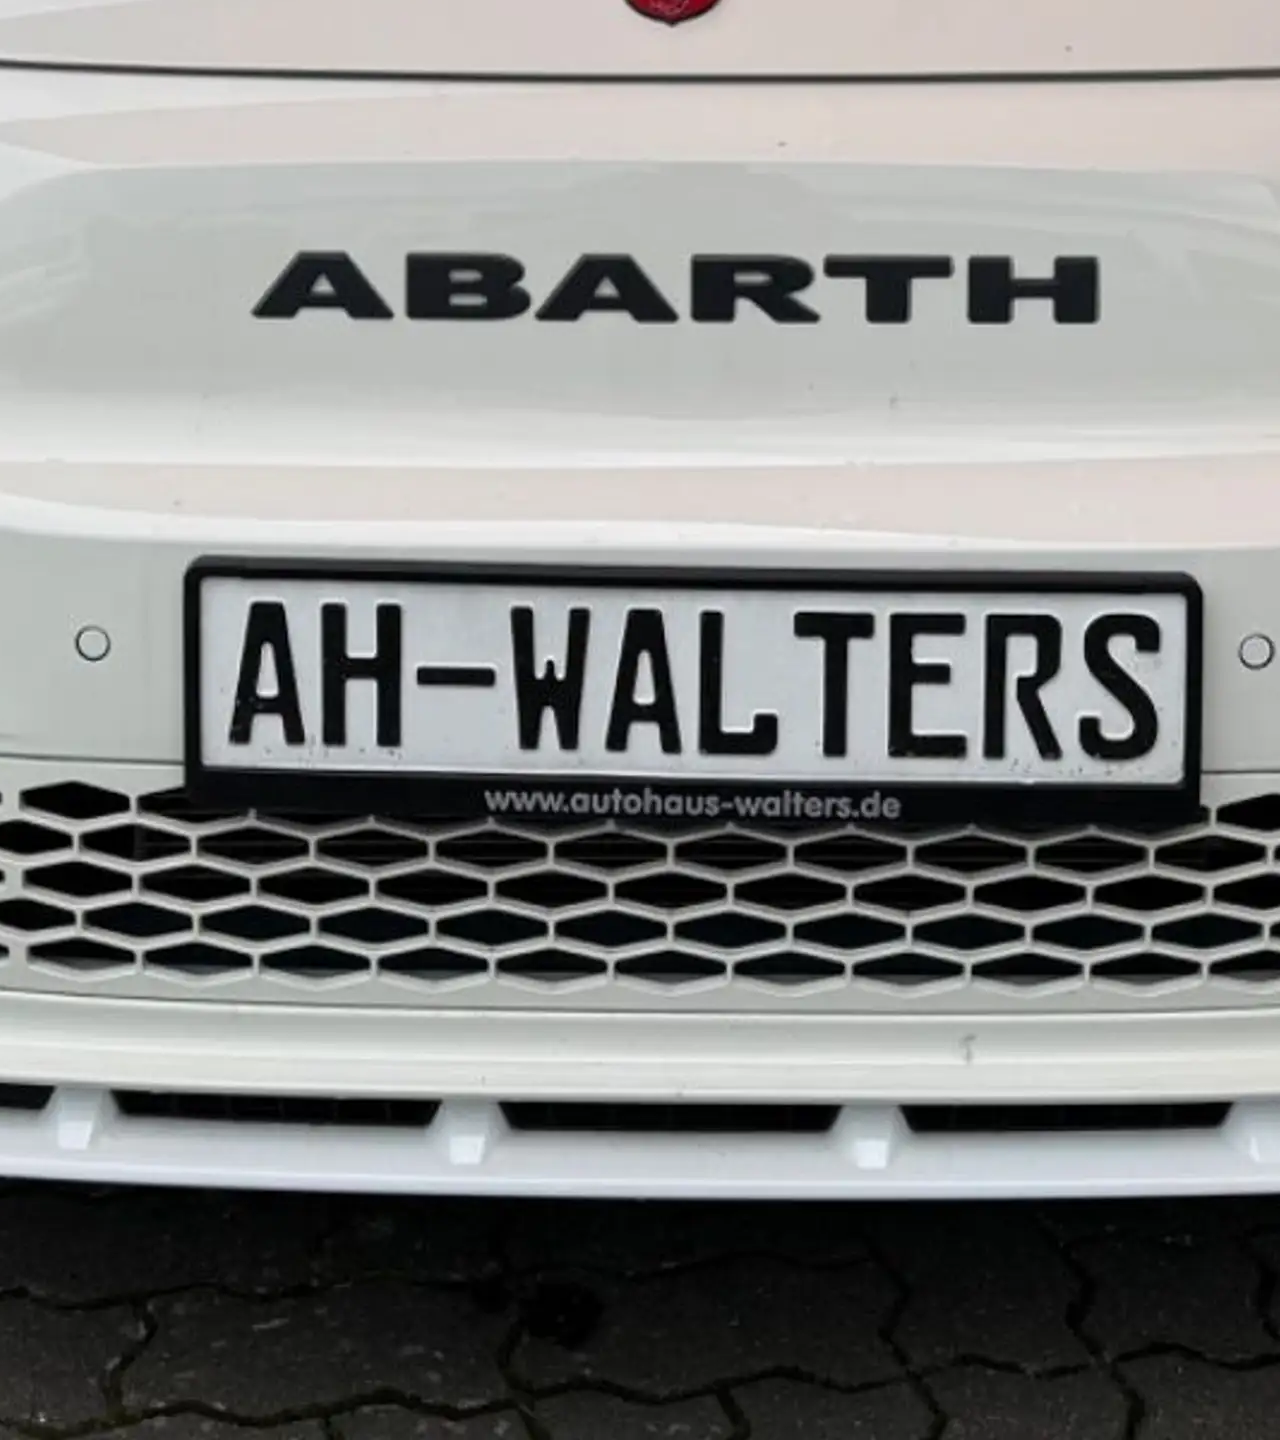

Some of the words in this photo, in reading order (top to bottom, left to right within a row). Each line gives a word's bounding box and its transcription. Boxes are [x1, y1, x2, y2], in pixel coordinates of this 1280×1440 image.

[251, 250, 1100, 325] ABARTH
[227, 600, 1162, 760] AH-WALTERS
[484, 788, 901, 819] www.autohaus-walters.de
